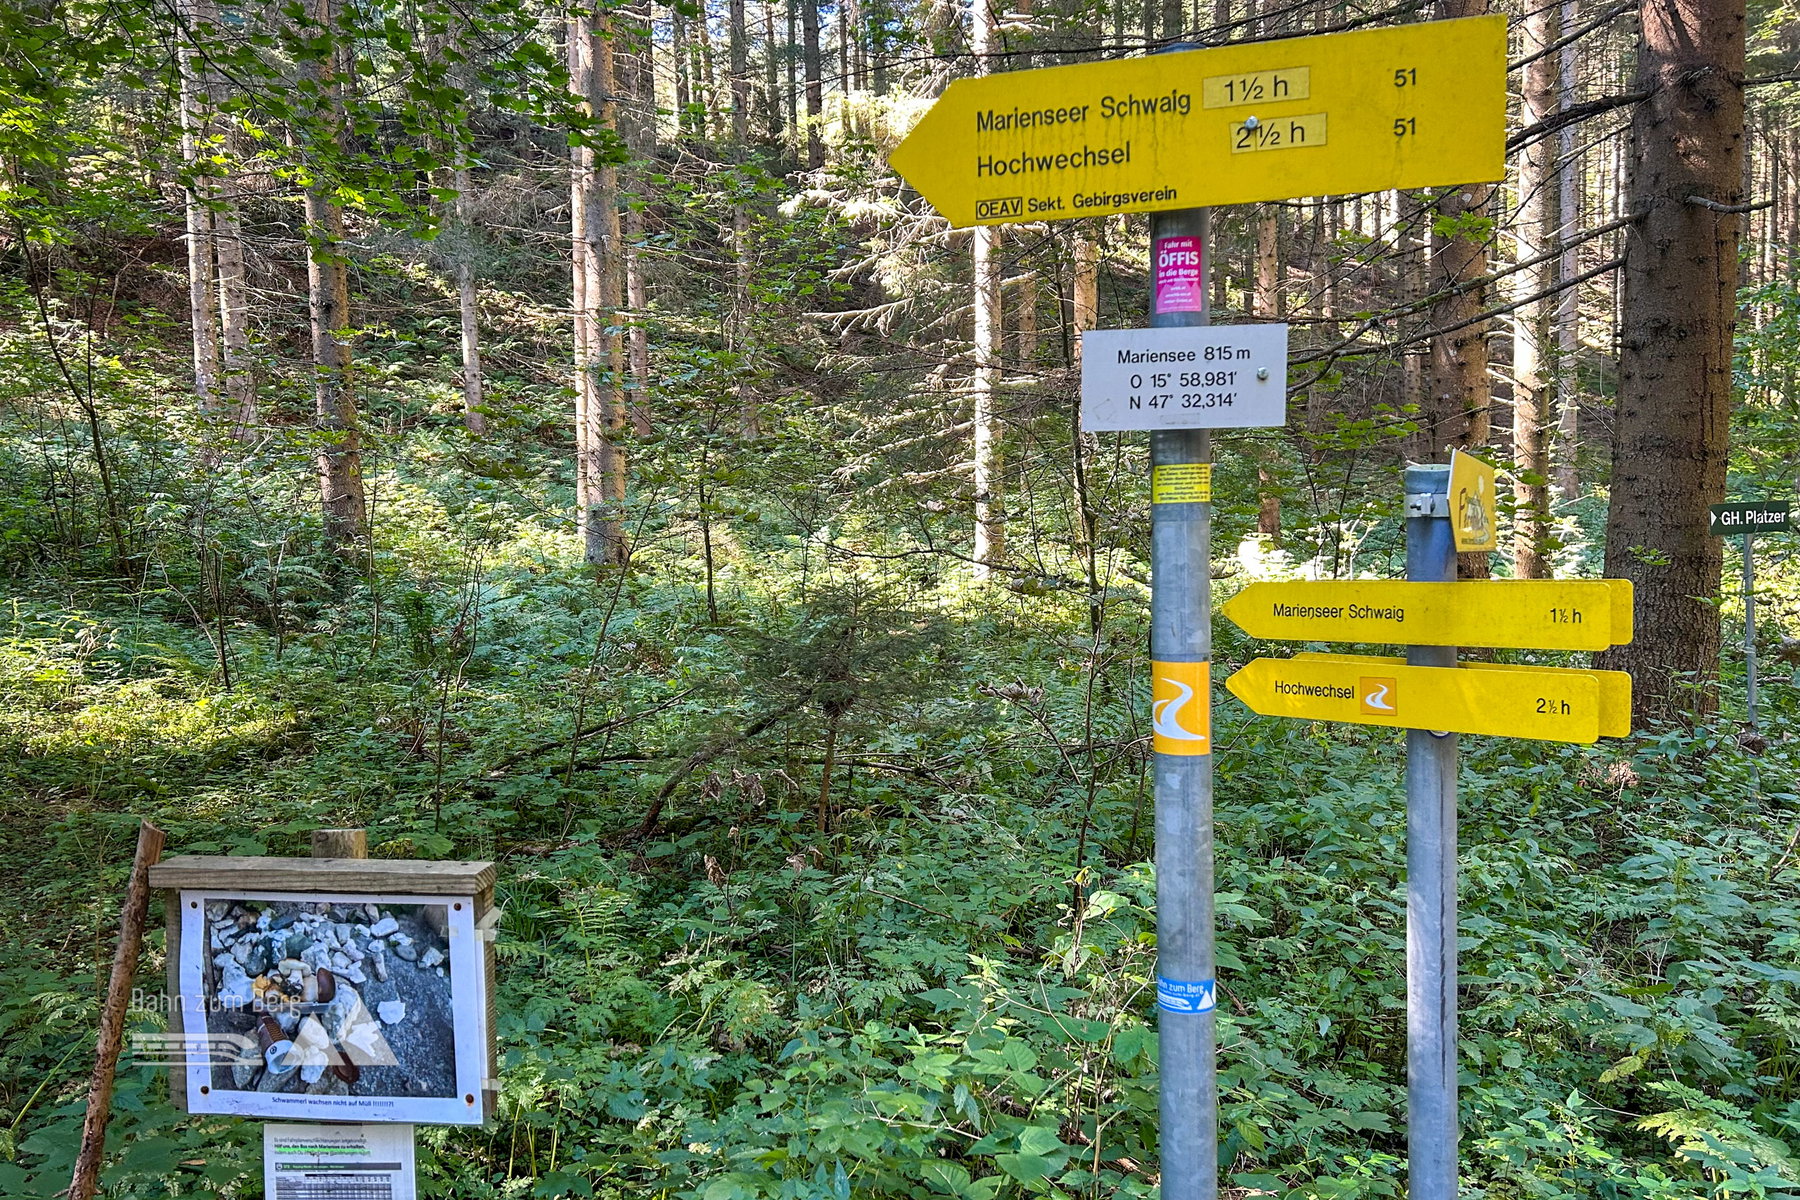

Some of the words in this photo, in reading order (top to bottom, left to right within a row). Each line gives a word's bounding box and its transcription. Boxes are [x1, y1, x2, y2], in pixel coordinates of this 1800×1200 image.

[1273, 75, 1289, 97] h
[1394, 68, 1417, 88] 51
[977, 105, 1089, 132] Marienseer
[1100, 89, 1191, 119] Schwaig
[1290, 121, 1305, 143] h
[1393, 117, 1416, 137] 51
[977, 141, 1131, 177] Hochwechsel
[978, 199, 1021, 217] OEAV
[1027, 197, 1065, 213] Sekt.
[1072, 186, 1177, 209] Gebirgsverein
[1180, 239, 1193, 248] mit
[1158, 250, 1199, 268] ÖFFIS
[1158, 269, 1165, 278] in
[1166, 268, 1177, 277] die
[1117, 348, 1196, 364] Mariensee
[1204, 346, 1233, 361] 815
[1236, 348, 1250, 360] m
[1130, 374, 1142, 389] O
[1150, 373, 1172, 388] 15°
[1129, 396, 1141, 410] N
[1148, 394, 1174, 409] 47°
[1721, 510, 1743, 526] GH.
[1745, 510, 1786, 525] Platzer
[1273, 603, 1344, 619] Marienseer
[1348, 603, 1404, 622] Schwaig
[1572, 608, 1582, 623] h
[1275, 680, 1355, 699] Hochwechsel
[1561, 700, 1570, 715] h
[1169, 983, 1186, 992] zum
[1186, 983, 1204, 995] Berg
